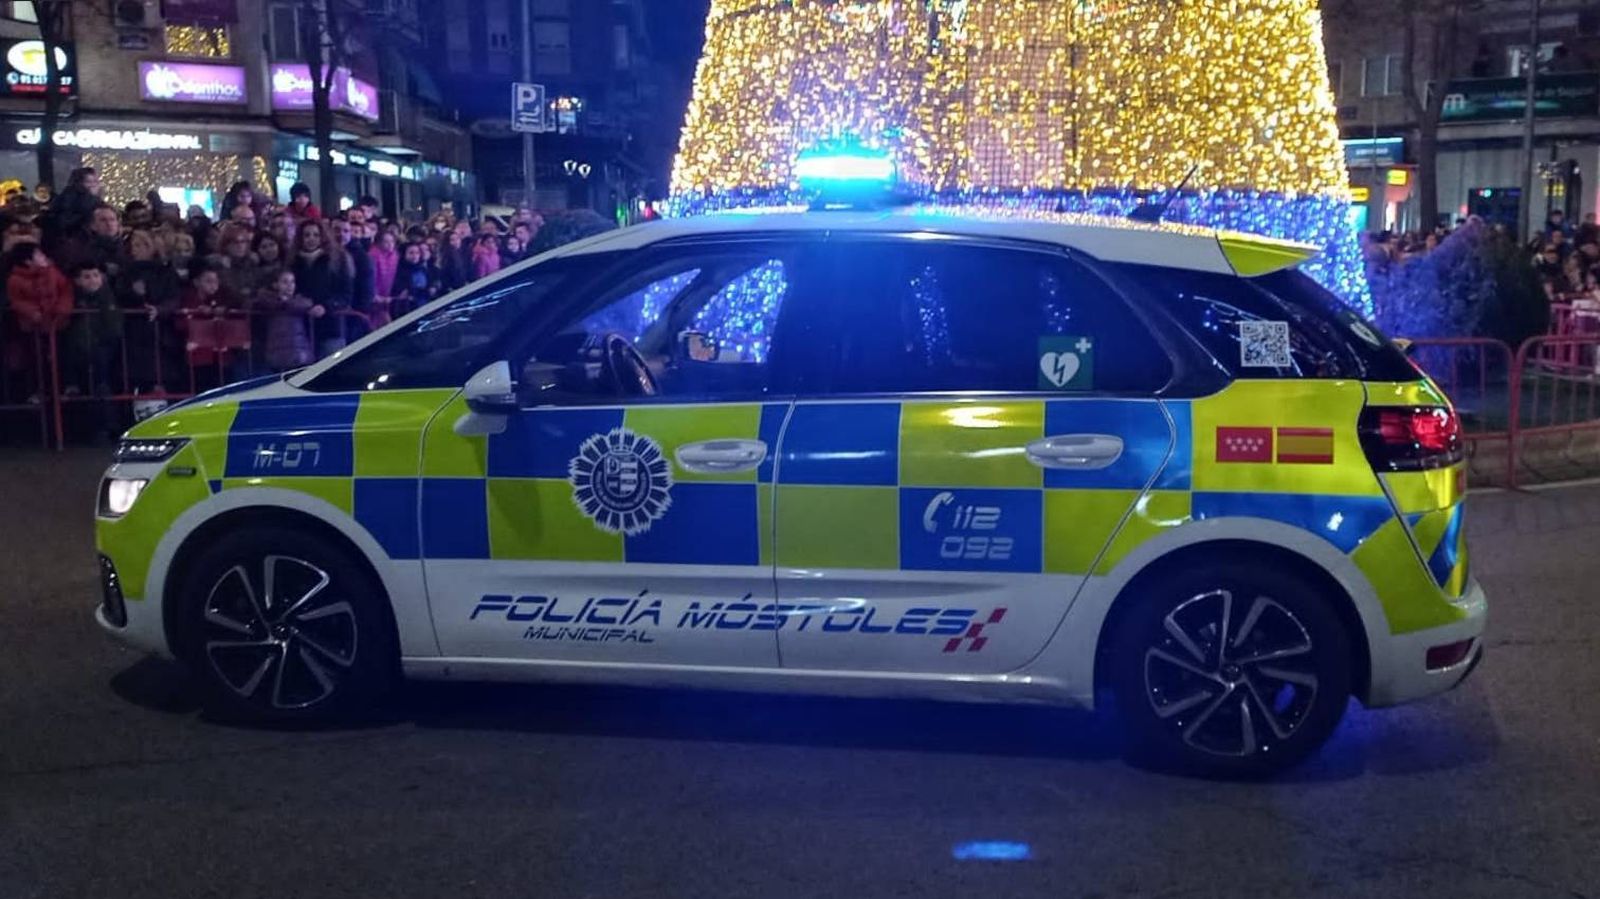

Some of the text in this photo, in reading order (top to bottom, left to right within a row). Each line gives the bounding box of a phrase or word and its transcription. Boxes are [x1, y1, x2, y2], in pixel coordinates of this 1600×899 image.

[517, 86, 537, 110] P
[252, 442, 320, 469] M-07
[953, 505, 1001, 530] 112
[941, 537, 1014, 559] 092
[469, 589, 978, 636] POLICÍA MÓSTOLES
[523, 626, 655, 643] MUNICIPAL
